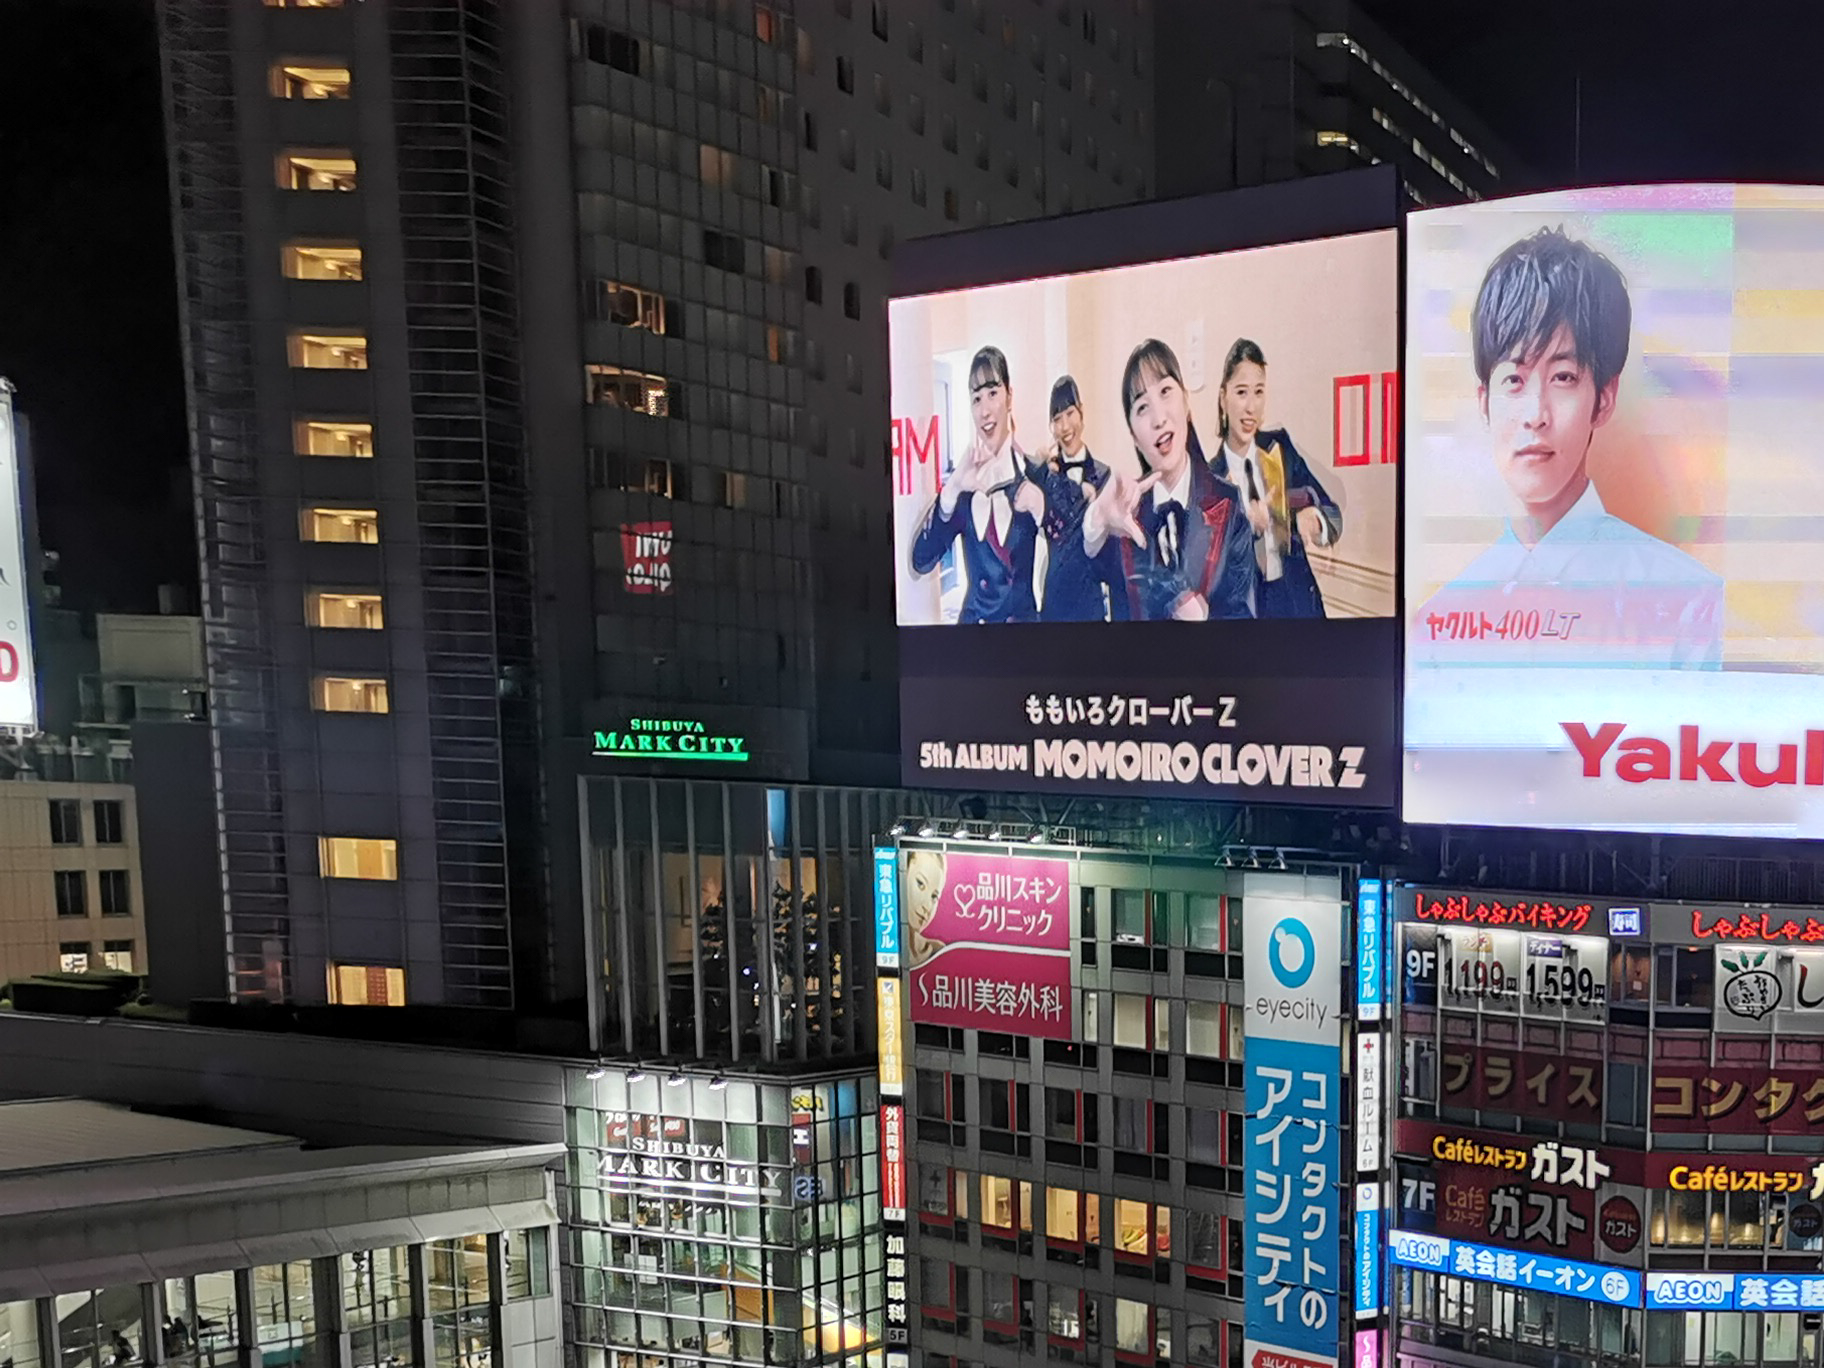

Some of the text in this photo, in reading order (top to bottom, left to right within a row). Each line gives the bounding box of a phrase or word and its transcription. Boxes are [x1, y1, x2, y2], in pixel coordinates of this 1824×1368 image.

[630, 718, 704, 732] SHIBUYA
[1026, 694, 1236, 728] ももいろクローバーZ
[594, 732, 744, 753] MARK CITY
[920, 740, 1365, 788] 5th ALBUM MOMOIRO CLOVER Z
[977, 871, 1061, 906] 品川スキン
[878, 864, 895, 949] 東急リバブル
[978, 907, 1053, 937] クリニック
[1415, 893, 1593, 931] しゃぶしゃぶバイキング
[882, 955, 895, 965] 9F
[1361, 899, 1376, 998] 東急リバブル
[1406, 950, 1436, 978] 9F
[931, 975, 1064, 1023] 品川美容外科
[1256, 997, 1328, 1024] eyecity
[1363, 1006, 1375, 1017] 9F
[1442, 1051, 1600, 1106] プライス
[1362, 1067, 1375, 1153] 献血ルーム
[632, 1136, 726, 1158] SHIBUYA
[701, 1163, 781, 1190] CITY
[1531, 1141, 1611, 1189] ガスト
[1255, 1066, 1294, 1323] アイシティ
[1300, 1072, 1328, 1330] コンタクトの
[1402, 1178, 1436, 1211] 7F
[1445, 1184, 1486, 1209] Café
[1445, 1210, 1485, 1228] レストラン
[1489, 1186, 1585, 1246] ガスト
[1605, 1219, 1637, 1239] ガスト
[1396, 1238, 1625, 1293] AEON 英会話イーオン 6F
[1657, 1281, 1722, 1301] AEON
[890, 1329, 905, 1342] 5F
